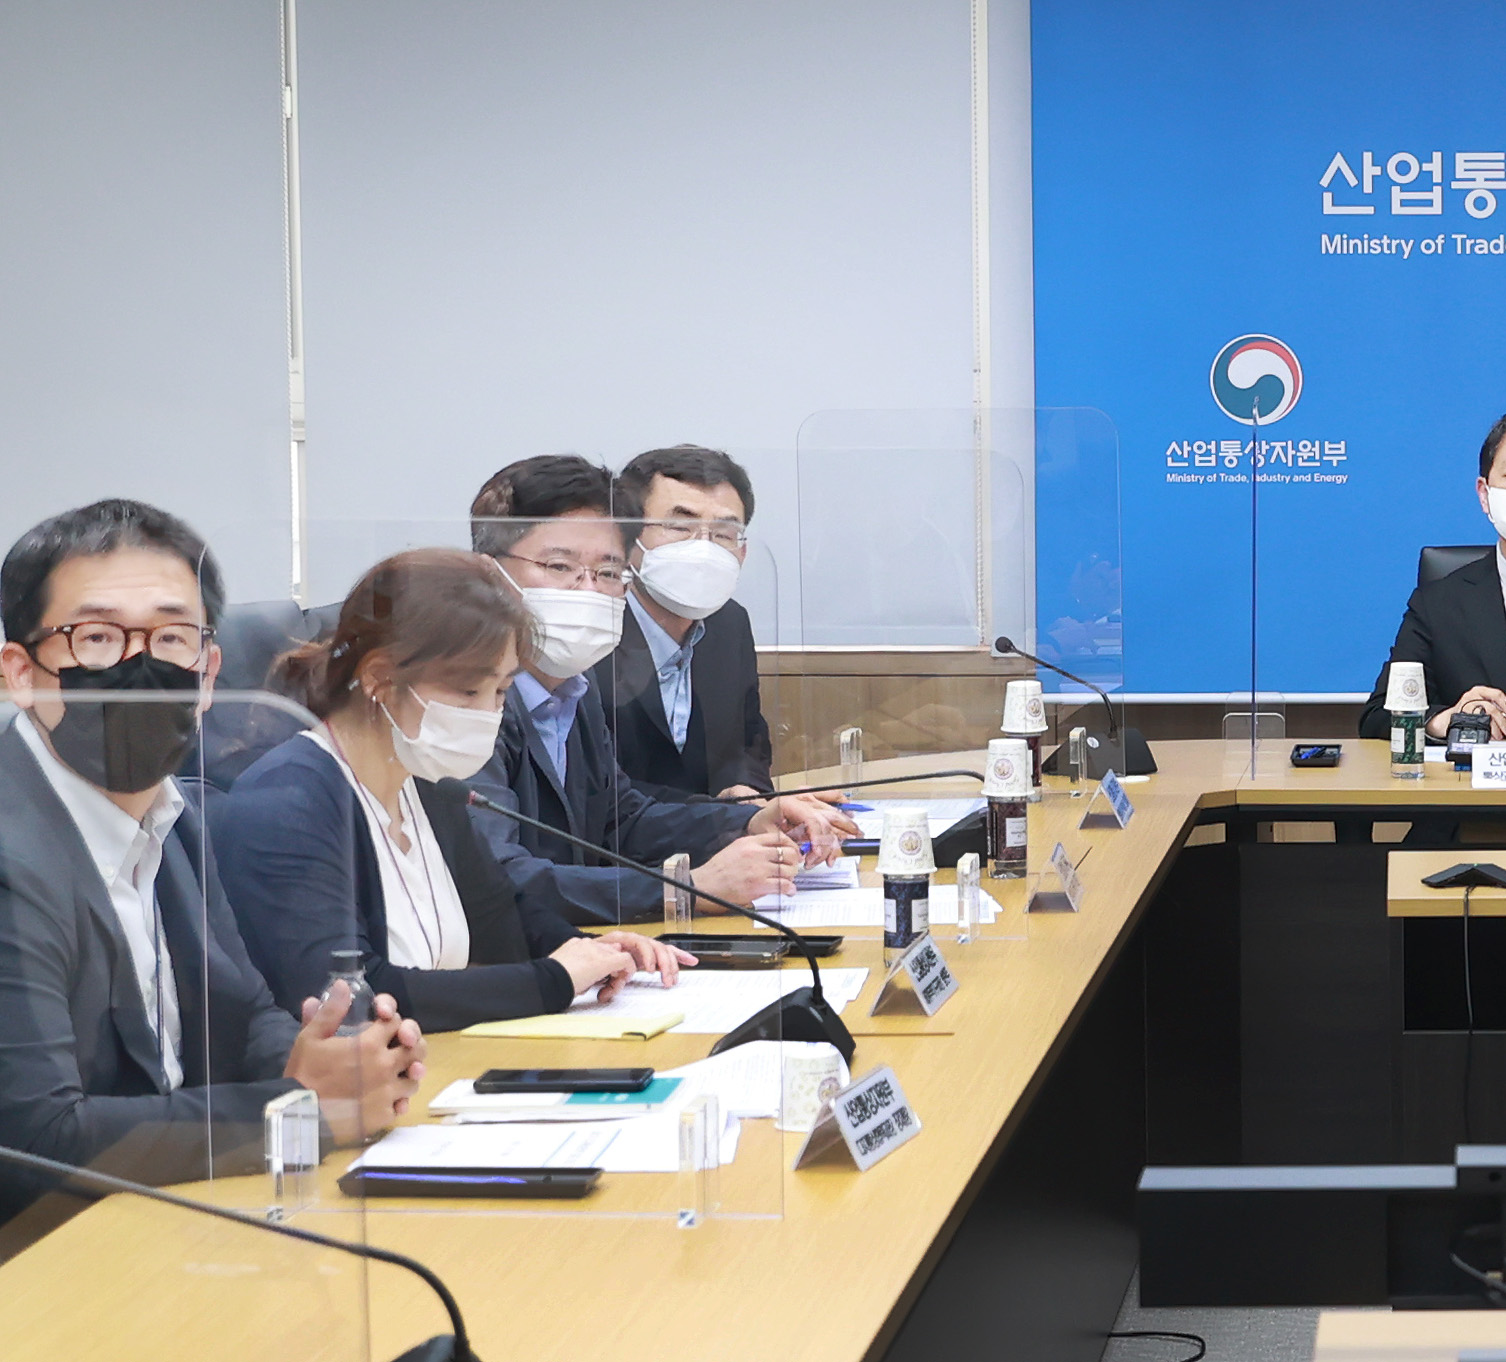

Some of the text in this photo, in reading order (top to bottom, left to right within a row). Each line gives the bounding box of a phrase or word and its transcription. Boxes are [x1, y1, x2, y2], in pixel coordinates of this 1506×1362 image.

[1320, 233, 1414, 260] Ministry
[1420, 233, 1445, 255] of
[1165, 439, 1348, 468] 산업통상자원부
[1166, 473, 1205, 484] Ministry
[1206, 472, 1217, 483] of
[1219, 472, 1250, 484] Trade,
[1292, 473, 1312, 483] and
[1313, 473, 1348, 484] Energy
